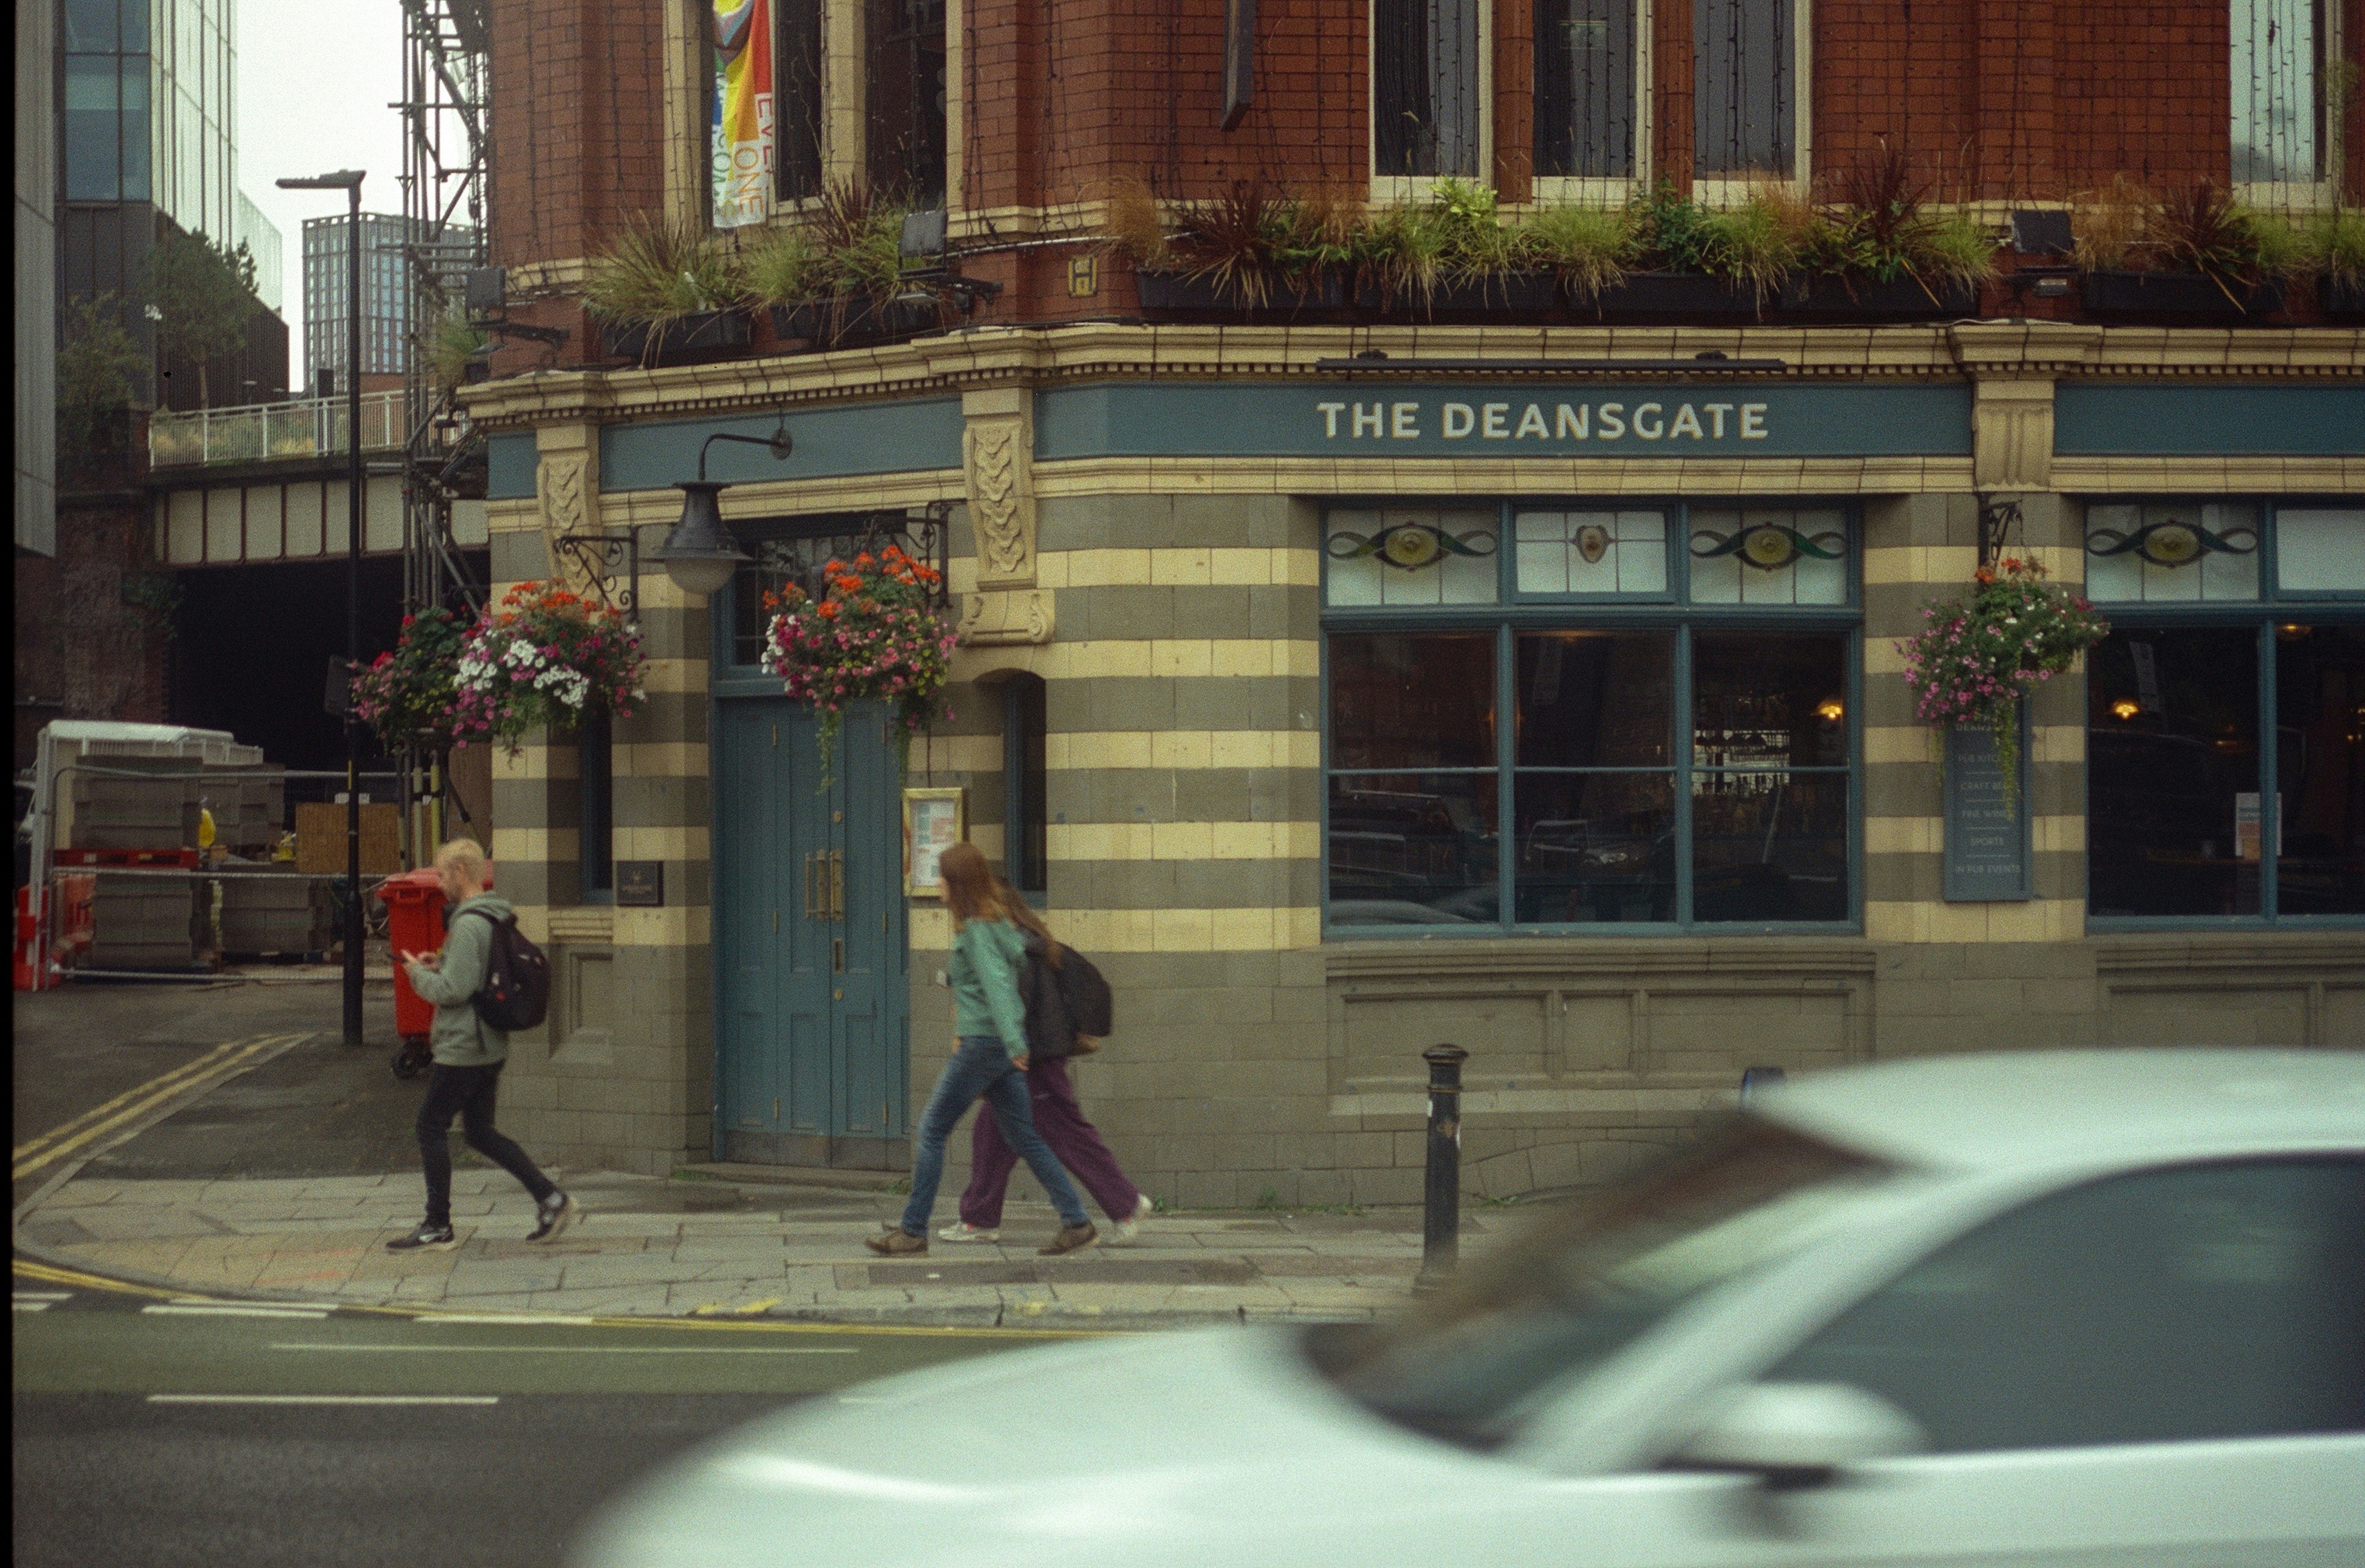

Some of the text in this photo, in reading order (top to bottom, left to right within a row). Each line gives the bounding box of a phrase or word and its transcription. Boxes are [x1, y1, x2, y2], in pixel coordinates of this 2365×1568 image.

[757, 98, 773, 174] EVE
[733, 147, 763, 214] ONE
[1316, 402, 1769, 439] THE DEANSGATE
[1961, 782, 1989, 790] CRAFT
[1983, 809, 2007, 818] WINE
[1987, 864, 2020, 873] EVENTS
